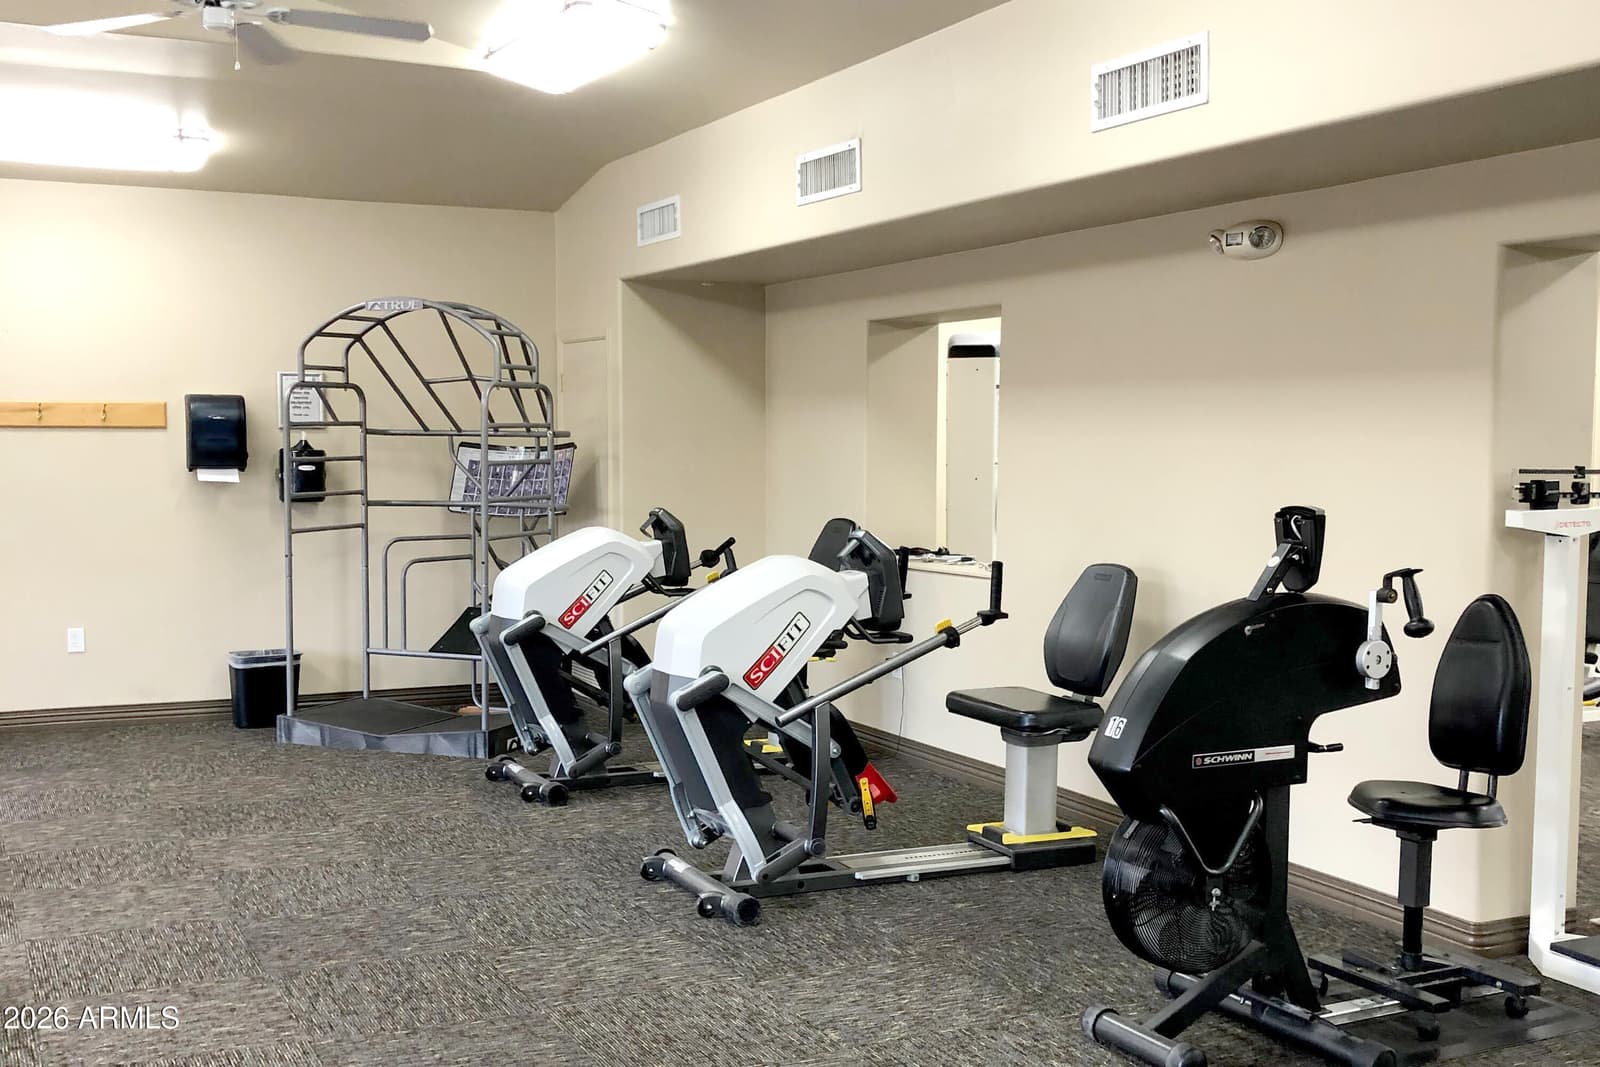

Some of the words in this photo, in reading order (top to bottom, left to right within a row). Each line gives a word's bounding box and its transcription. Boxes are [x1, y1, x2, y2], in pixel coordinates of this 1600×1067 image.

[563, 574, 606, 625] SCIFIT
[750, 618, 802, 684] SCIFIT
[1108, 718, 1125, 737] 16
[1203, 752, 1253, 765] SCHWINN
